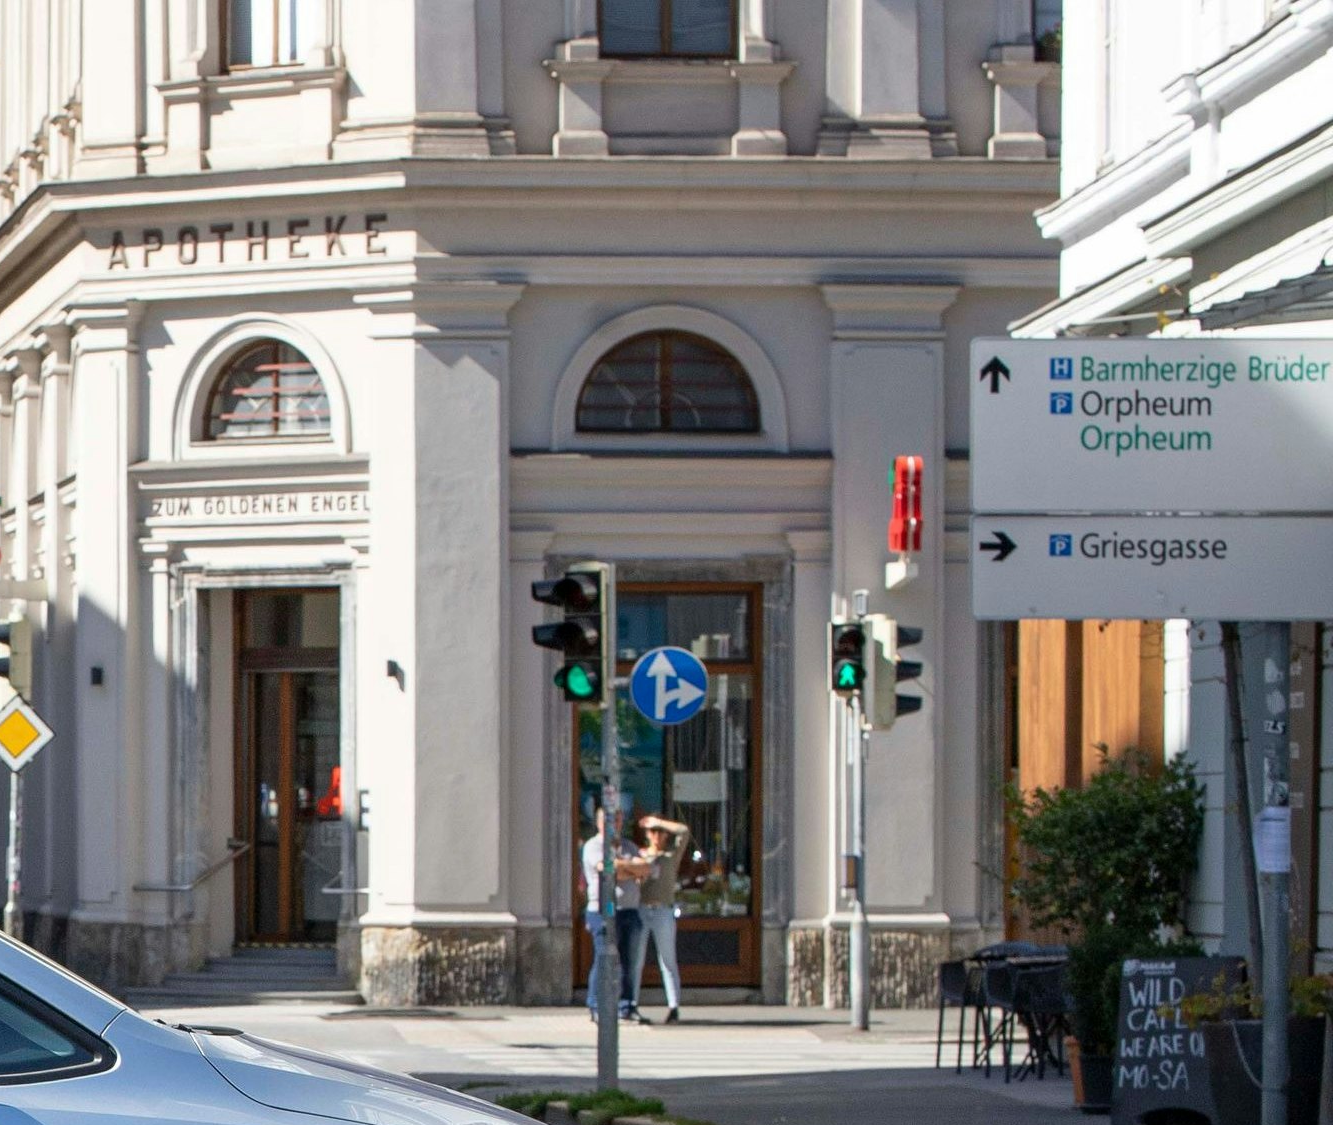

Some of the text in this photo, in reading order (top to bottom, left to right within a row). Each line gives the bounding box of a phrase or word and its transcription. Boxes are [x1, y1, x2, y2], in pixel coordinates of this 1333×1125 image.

[108, 212, 388, 270] APOTHEKE
[1081, 355, 1236, 388] Barmherzige
[1248, 355, 1330, 382] Brüder
[1081, 389, 1212, 422] Orpheum
[1081, 424, 1212, 457] Orpheum
[152, 494, 371, 517] ZUM GOLDENEN ENGEL
[1081, 532, 1228, 566] Griesgasse
[1129, 977, 1184, 1007] WILD
[1120, 1037, 1144, 1058] WE
[1147, 1034, 1183, 1058] ARE
[1118, 1059, 1190, 1091] MO-SA
